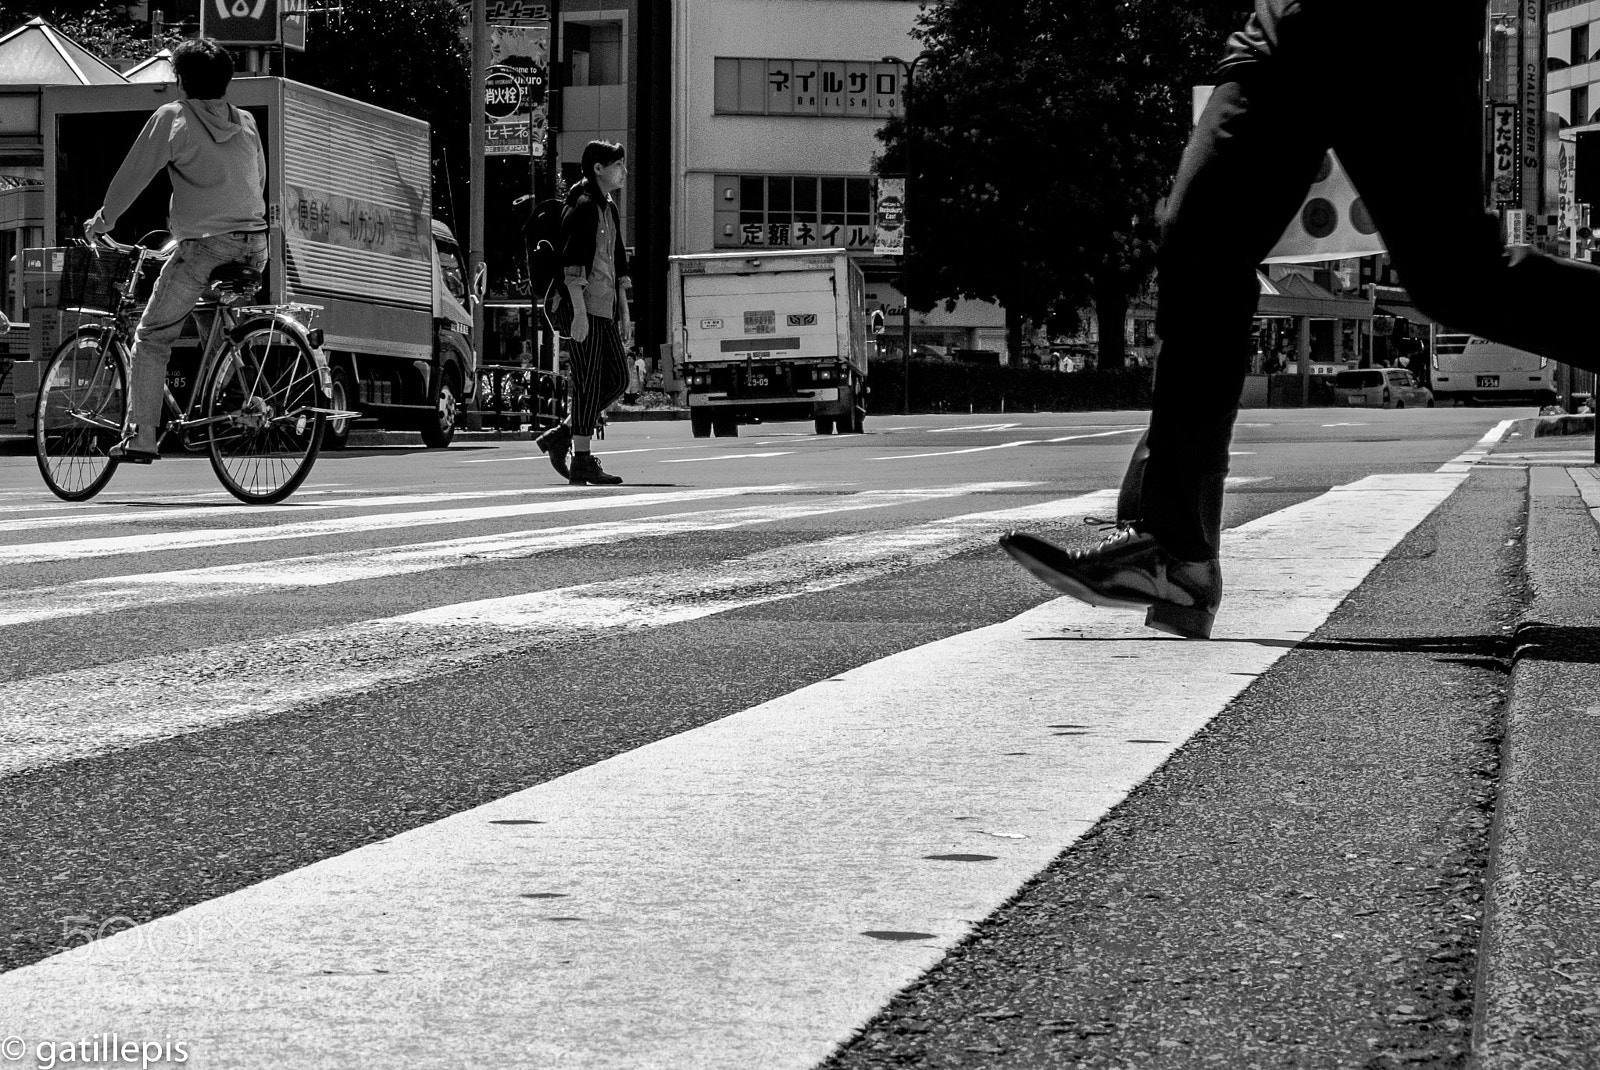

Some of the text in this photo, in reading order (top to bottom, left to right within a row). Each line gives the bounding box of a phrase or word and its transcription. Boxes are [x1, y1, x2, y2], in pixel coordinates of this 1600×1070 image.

[769, 70, 898, 95] ネイルサロ
[485, 87, 517, 105] 消火栓
[1524, 63, 1537, 169] CHALLENGER S
[743, 224, 871, 247] 定額ネイル
